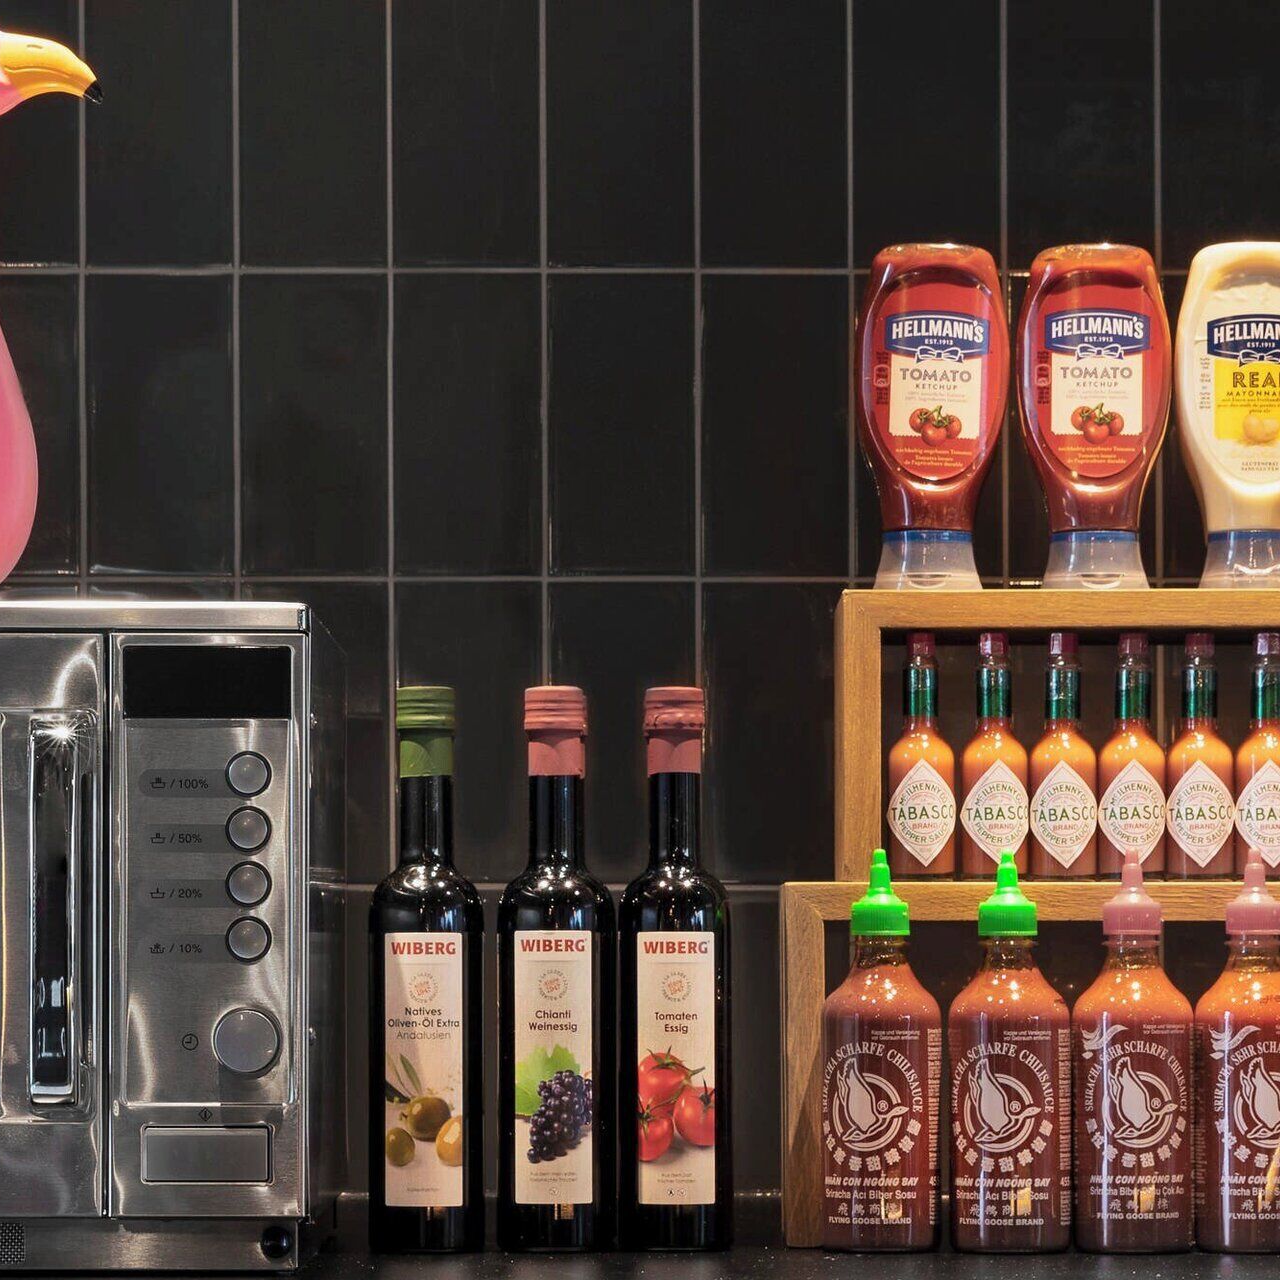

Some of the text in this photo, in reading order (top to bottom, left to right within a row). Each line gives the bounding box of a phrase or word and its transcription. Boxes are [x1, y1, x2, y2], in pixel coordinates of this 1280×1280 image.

[892, 320, 984, 343] HELLMANN'S
[1052, 316, 1143, 339] HELLMANN'S
[900, 368, 972, 382] TOMATO
[1061, 367, 1133, 379] TOMATO
[178, 779, 209, 789] 100%
[891, 805, 953, 820] TABASCO
[1033, 806, 1095, 822] TABASCO
[1102, 805, 1164, 820] TABASCO
[1169, 805, 1232, 821] TABASCO
[178, 834, 202, 844] 50%
[178, 889, 202, 899] 20%
[178, 943, 202, 954] 10%
[391, 942, 456, 955] WIBERG
[521, 939, 585, 952] WIBERG
[644, 941, 708, 954] WIBERG
[405, 1007, 442, 1015] Natives
[535, 1010, 571, 1019] Chianti
[654, 1012, 697, 1020] Tomaten
[437, 1019, 460, 1027] Extra
[529, 1022, 577, 1032] Weinessig
[664, 1024, 688, 1034] Essig
[397, 1031, 451, 1039] Andalusien
[1230, 1045, 1257, 1066] SEHR
[836, 1042, 885, 1061] SCHARFE
[887, 1049, 923, 1113] CHILISAUCE
[967, 1042, 1018, 1062] SCHARFE
[1019, 1049, 1054, 1113] CHILISAUCE
[1085, 1063, 1102, 1112] SRIRACHA
[1124, 1040, 1168, 1060] SCHARFE
[1167, 1055, 1187, 1112] CHILISAUCE
[843, 1176, 919, 1186] CON BAY
[1034, 1178, 1051, 1186] BAY
[1115, 1175, 1135, 1184] CON
[825, 1188, 851, 1198] Sriracha
[869, 1190, 893, 1199] Biber
[895, 1190, 917, 1198] Sosu
[956, 1190, 983, 1199] Srirach
[1090, 1186, 1118, 1195] Srircha
